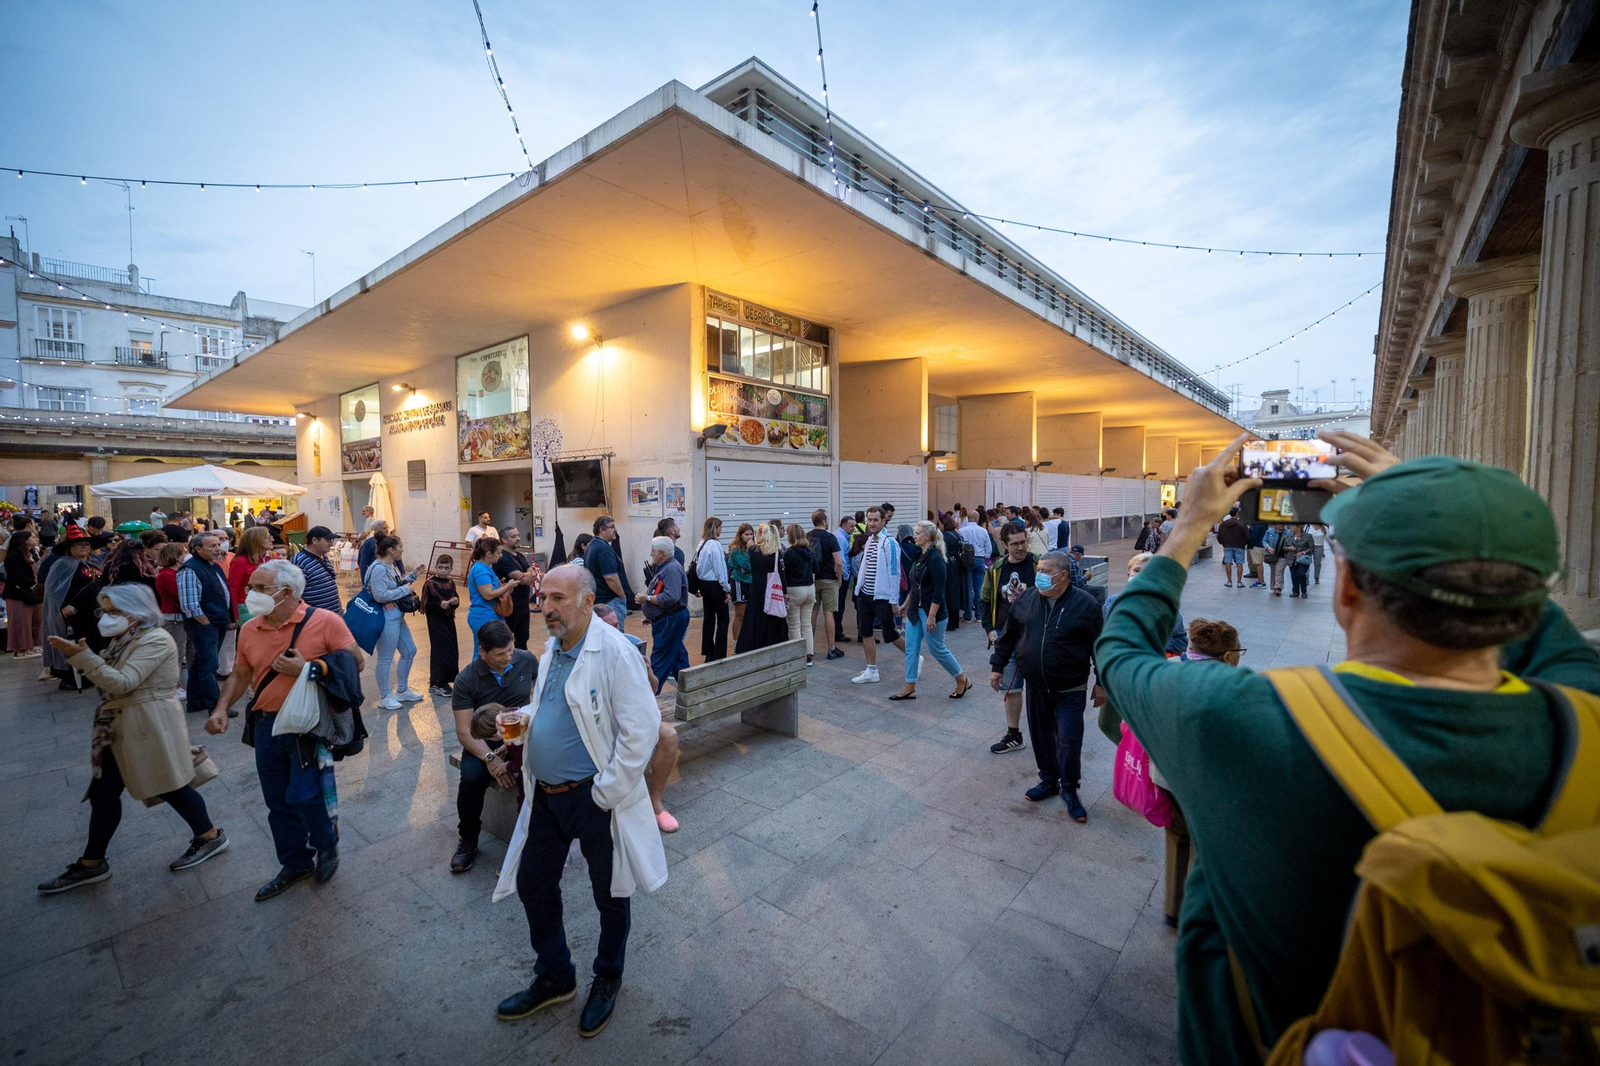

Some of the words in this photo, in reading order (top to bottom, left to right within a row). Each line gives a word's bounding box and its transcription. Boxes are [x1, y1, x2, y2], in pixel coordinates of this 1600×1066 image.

[708, 294, 732, 311] TAPAS
[745, 305, 783, 327] DESAYUNOS
[713, 465, 721, 473] 94
